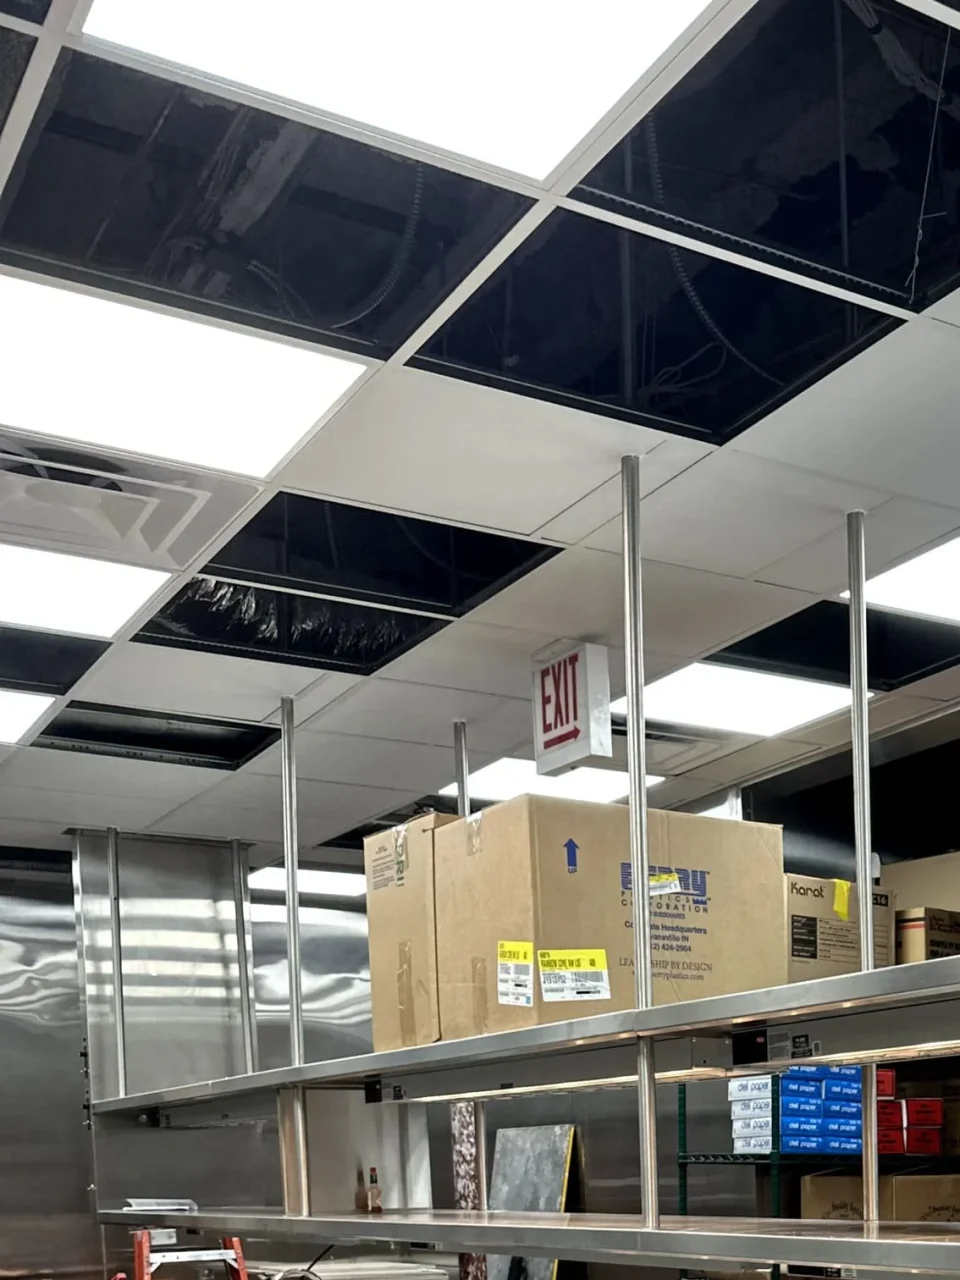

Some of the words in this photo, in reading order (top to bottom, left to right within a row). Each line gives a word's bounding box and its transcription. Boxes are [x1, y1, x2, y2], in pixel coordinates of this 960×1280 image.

[541, 652, 579, 734] EXIT
[568, 866, 577, 874] UP
[791, 881, 824, 898] Karat
[661, 923, 707, 934] Headquarters
[650, 933, 680, 942] vansville
[661, 943, 692, 952] 424-2904
[619, 957, 670, 969] LEASHIP
[671, 961, 681, 970] BY
[682, 961, 713, 972] DESIGN
[750, 1081, 769, 1090] paper
